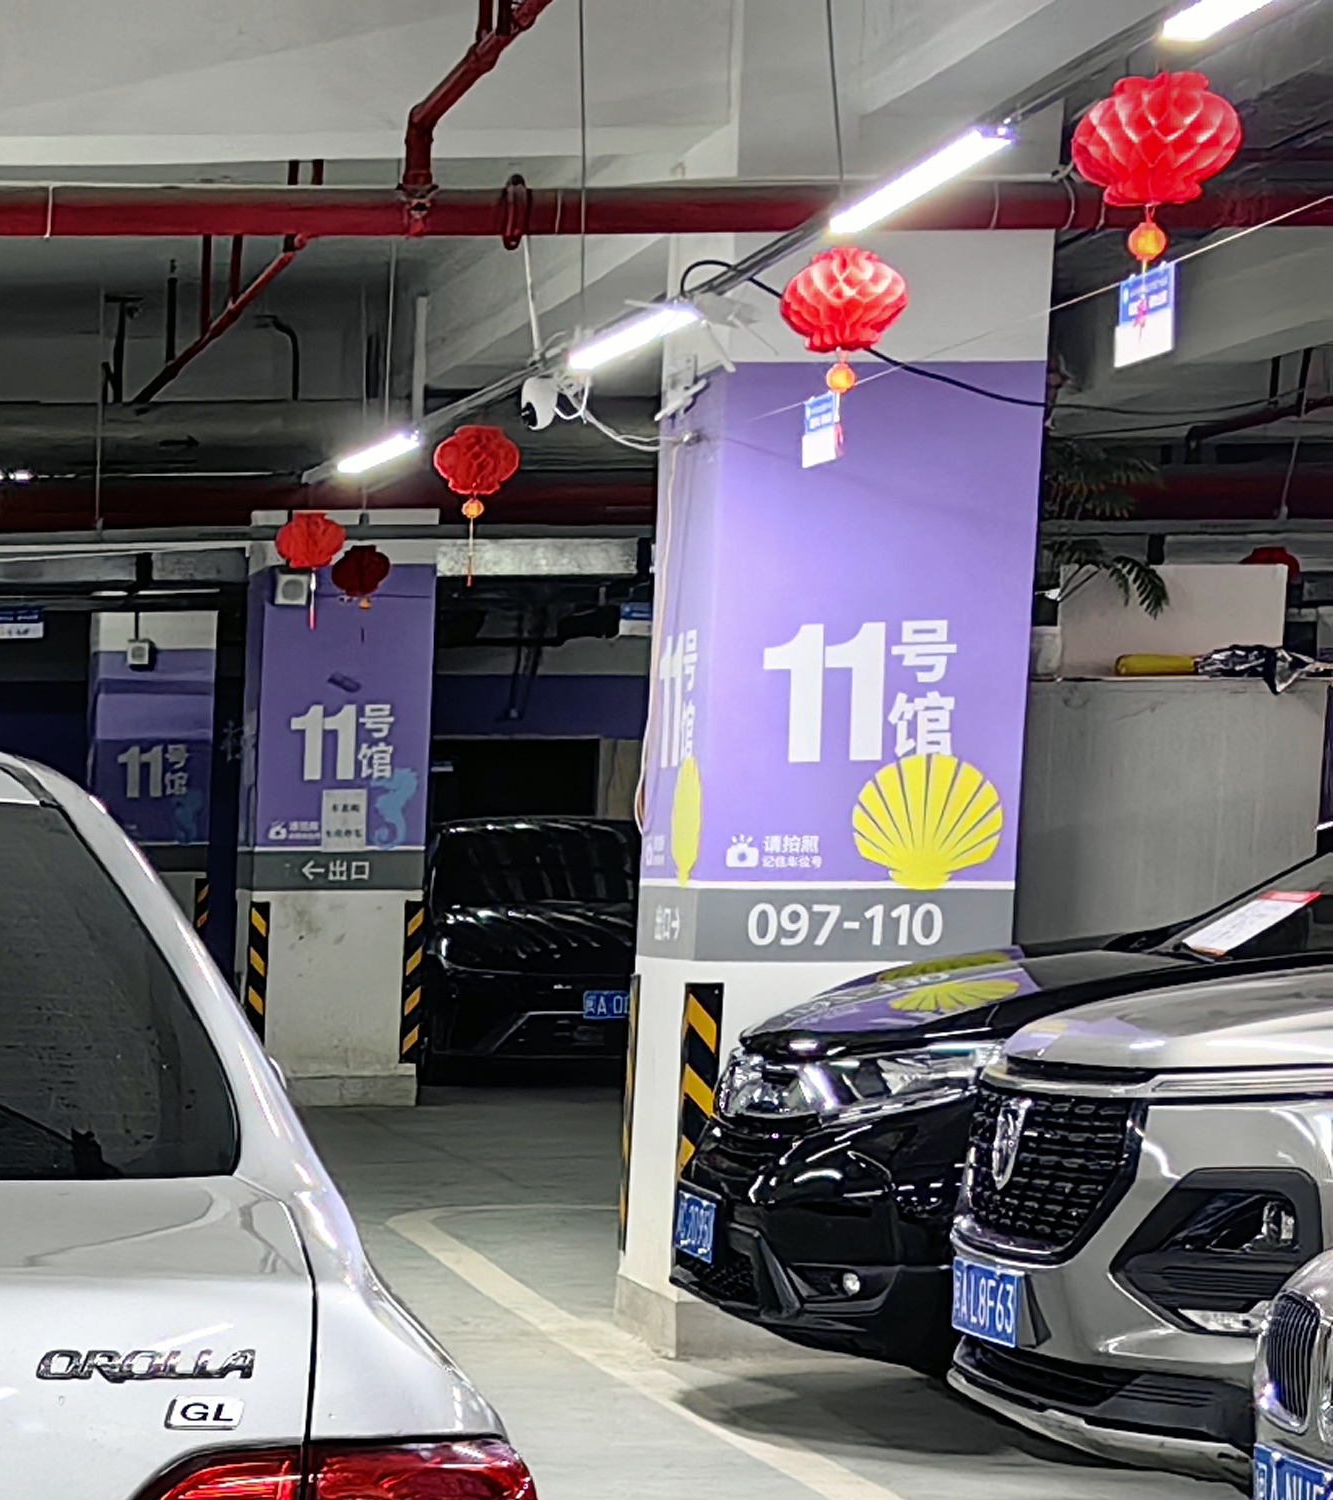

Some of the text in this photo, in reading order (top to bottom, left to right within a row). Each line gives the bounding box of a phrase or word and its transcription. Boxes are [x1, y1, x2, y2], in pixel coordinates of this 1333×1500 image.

[762, 619, 957, 763] 11 号馆
[290, 704, 358, 781] 11
[358, 704, 395, 778] 号馆
[117, 744, 164, 799] 11
[328, 860, 370, 880] 出口
[747, 902, 944, 946] 097-110
[180, 1402, 234, 1422] GL
